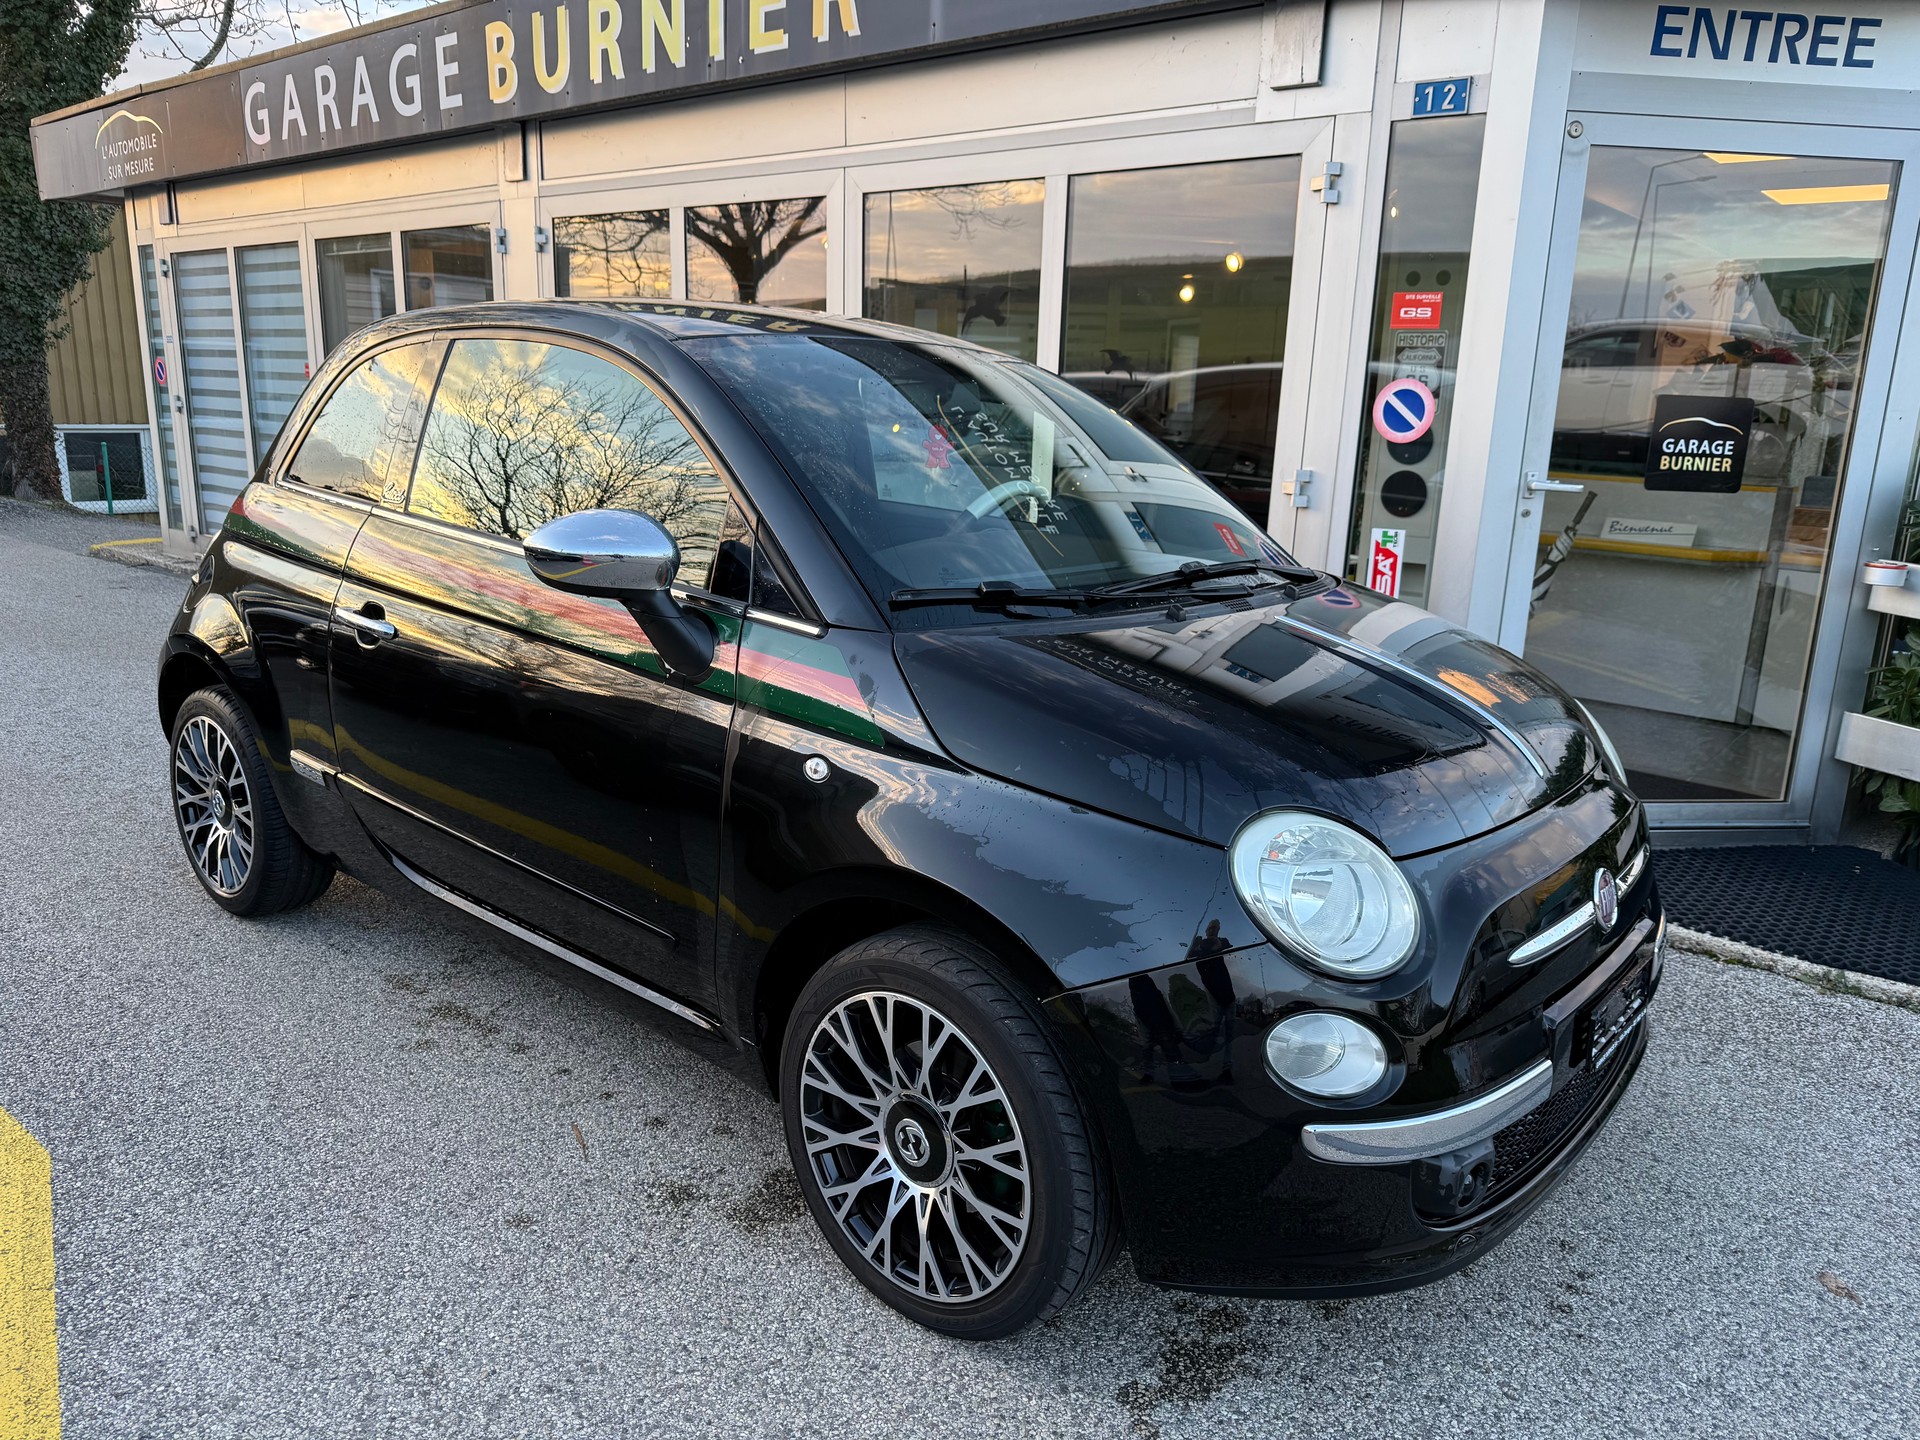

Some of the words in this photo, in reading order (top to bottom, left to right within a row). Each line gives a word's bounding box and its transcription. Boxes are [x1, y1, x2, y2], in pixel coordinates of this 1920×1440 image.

[1650, 5, 1883, 68] ENTREE
[245, 32, 463, 145] GARAGE
[1424, 84, 1457, 112] 12
[101, 133, 157, 160] L'AUTOMOBILE
[108, 164, 124, 180] SUR
[124, 157, 155, 177] MESURE
[1400, 307, 1432, 318] GS
[1399, 334, 1445, 346] HISTORIC
[1662, 438, 1734, 455] GARAGE
[1659, 455, 1732, 472] BURNIER
[1608, 520, 1675, 533] Bienvenue
